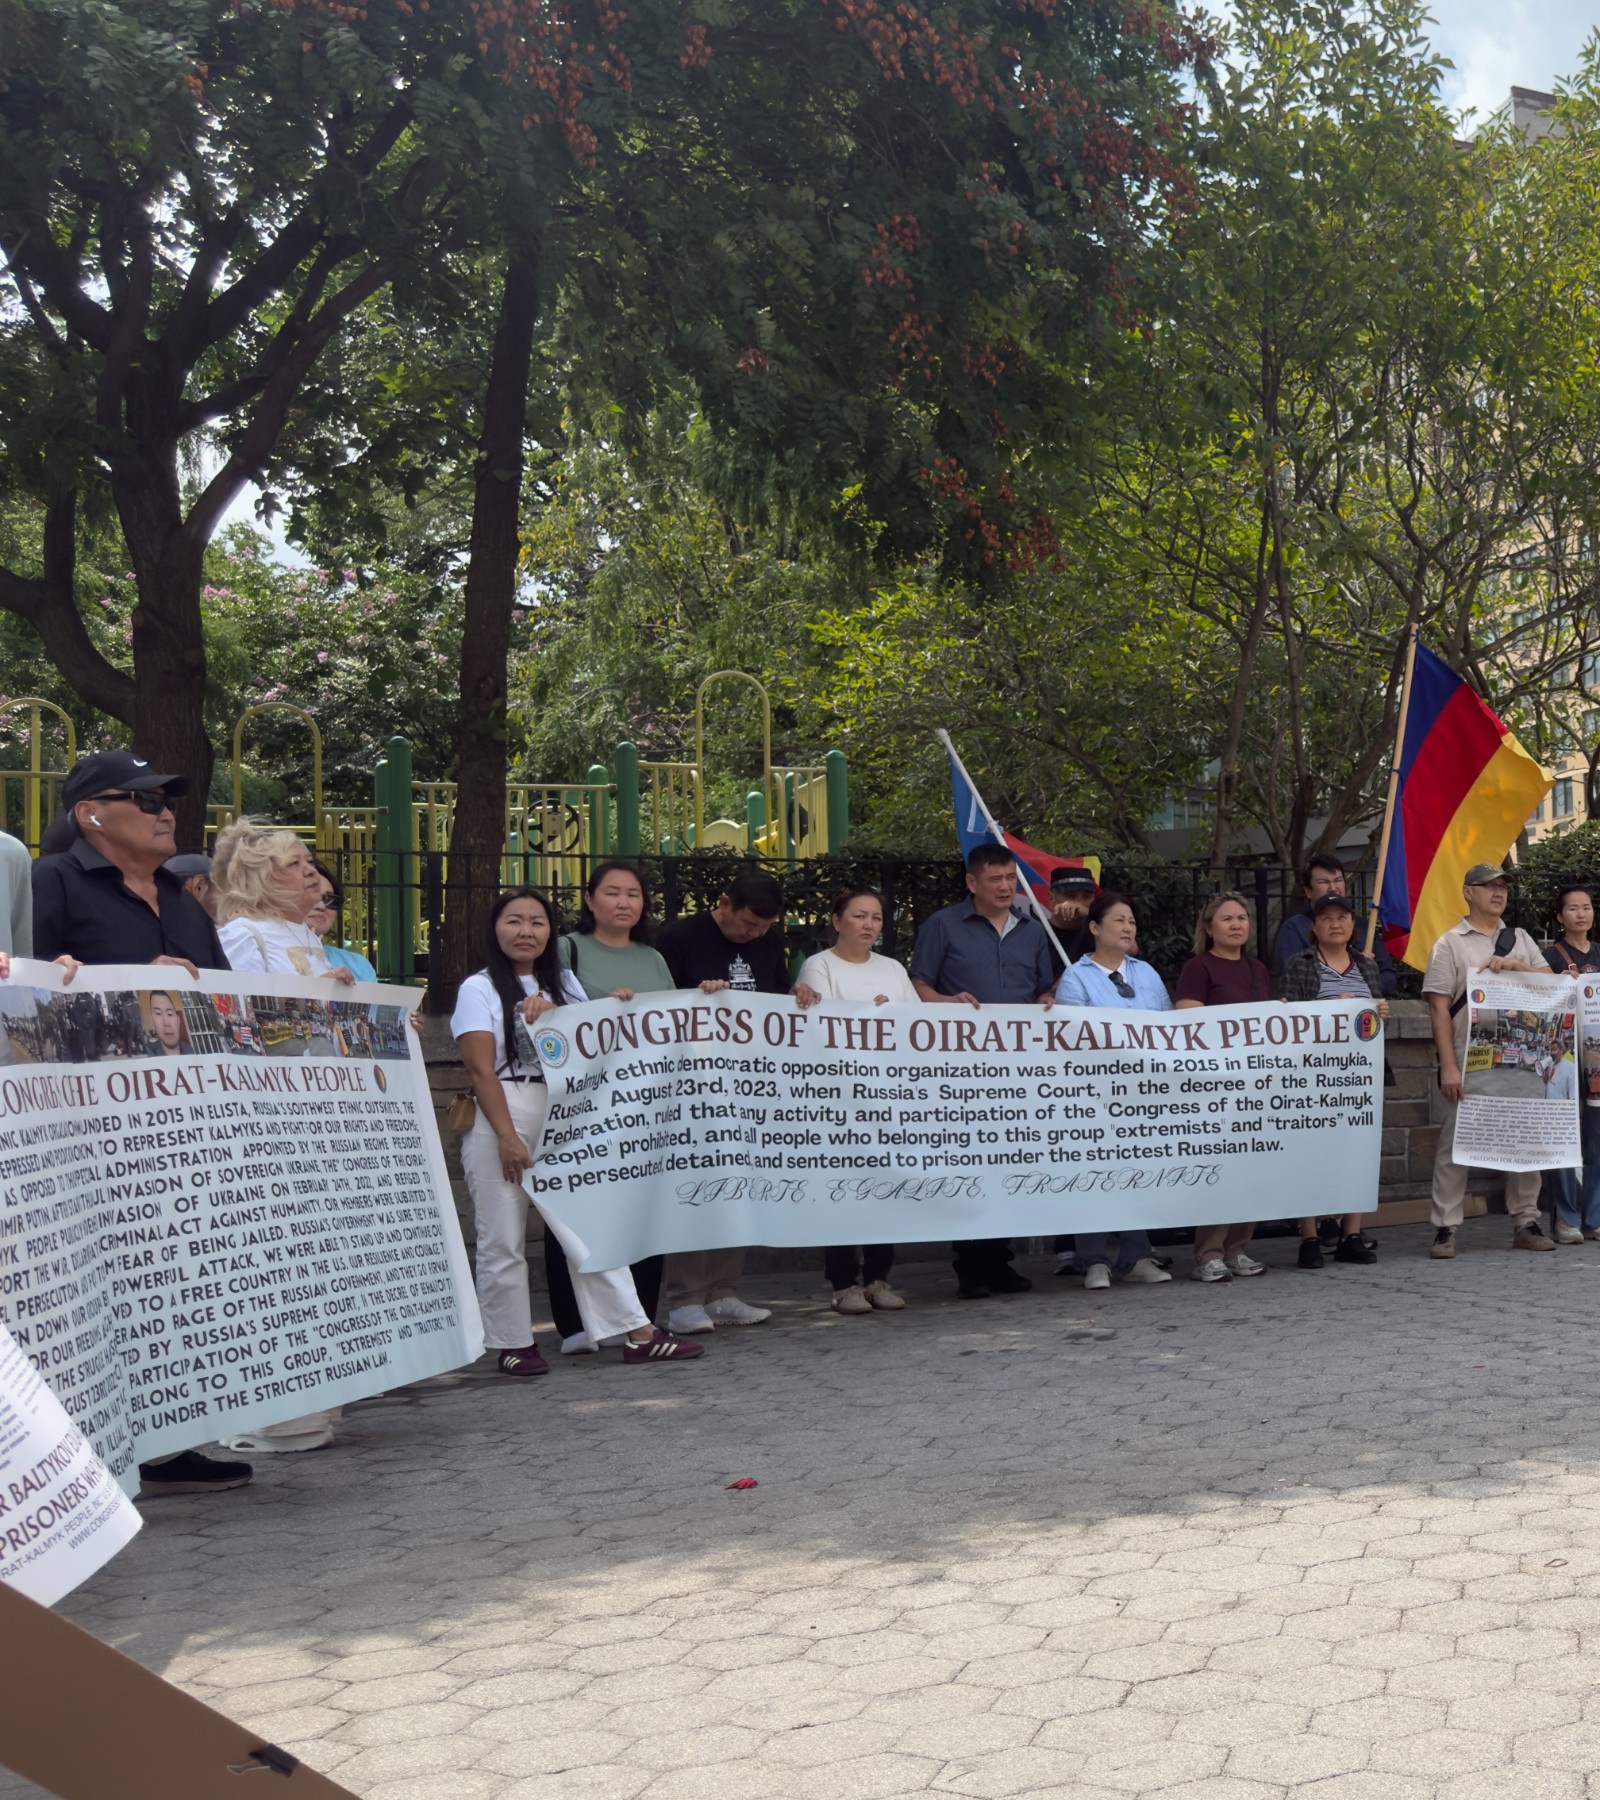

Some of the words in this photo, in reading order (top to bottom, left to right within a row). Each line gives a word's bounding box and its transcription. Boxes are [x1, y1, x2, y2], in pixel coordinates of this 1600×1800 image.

[575, 1007, 753, 1060] CONGRESS
[763, 1011, 807, 1047] OF
[819, 1015, 897, 1051] THE
[909, 1018, 1210, 1051] OIRAT-KALMYK
[1217, 1013, 1350, 1050] PEOPLE
[107, 1063, 300, 1104] OIRAT-KALMYK
[300, 1065, 367, 1093] PEOPLE
[565, 1067, 609, 1095] Kalmyk
[615, 1056, 675, 1081] ethnic
[677, 1055, 776, 1074] democratic
[781, 1060, 880, 1079] opposition
[886, 1061, 1010, 1081] organization
[1017, 1064, 1057, 1077] was
[1063, 1059, 1144, 1077] founded
[1151, 1057, 1167, 1073] in
[1173, 1058, 1219, 1073] 2015
[1225, 1056, 1241, 1071] in
[1247, 1054, 1298, 1071] Elista,
[1303, 1052, 1373, 1070] Kalmykia,
[548, 1097, 598, 1122] Russia.
[610, 1080, 673, 1107] August
[675, 1077, 728, 1097] 23rd,
[734, 1079, 781, 1101] 2023,
[790, 1082, 841, 1099] when
[853, 1083, 928, 1100] Russia's
[939, 1083, 1026, 1103] Supreme
[1037, 1082, 1101, 1100] Court,
[1111, 1080, 1127, 1096] in
[1137, 1080, 1170, 1095] the
[1180, 1077, 1245, 1093] decree
[1254, 1075, 1272, 1090] of
[1281, 1075, 1308, 1089] the
[1316, 1072, 1373, 1087] Russian
[146, 1107, 185, 1128] 2015
[208, 1101, 251, 1120] ELISTA,
[542, 1111, 650, 1147] Federation,
[655, 1107, 681, 1124] ruled
[689, 1102, 737, 1120] that
[740, 1106, 766, 1124] any
[774, 1105, 847, 1125] activity
[855, 1106, 892, 1122] and
[900, 1106, 1027, 1125] participation
[1035, 1105, 1056, 1120] of
[1064, 1104, 1096, 1119] the
[1103, 1101, 1200, 1119] "Congress
[1207, 1098, 1228, 1113] of
[1236, 1097, 1263, 1111] the
[1270, 1091, 1373, 1110] Oirat-Kalmyk
[123, 1127, 204, 1153] REPRESENT
[209, 1121, 264, 1142] KALMYKS
[619, 1128, 698, 1158] prohibited,
[705, 1126, 742, 1143] and
[744, 1127, 757, 1143] all
[761, 1130, 821, 1148] people
[828, 1130, 872, 1145] who
[878, 1129, 971, 1148] belonging
[977, 1129, 999, 1143] to
[1005, 1127, 1042, 1142] this
[1047, 1126, 1105, 1145] group
[1110, 1119, 1225, 1138] "extremists"
[1231, 1116, 1262, 1132] and
[1348, 1111, 1374, 1126] will
[106, 1146, 233, 1180] ADMINISTRATION
[218, 1162, 284, 1184] SOVEREIGN
[532, 1175, 562, 1193] be
[568, 1157, 664, 1192] persecuted,
[666, 1151, 753, 1171] detained,
[754, 1152, 782, 1168] and
[787, 1152, 891, 1169] sentenced
[896, 1153, 917, 1167] to
[922, 1153, 982, 1170] prison
[987, 1149, 1044, 1166] under
[1050, 1147, 1082, 1163] the
[1086, 1143, 1173, 1161] strictest
[1178, 1141, 1248, 1157] Russian
[1251, 1138, 1284, 1152] law.
[209, 1185, 266, 1207] UKRAINE
[242, 1226, 287, 1247] JAILED.
[112, 1266, 190, 1298] POWERFUL
[198, 1253, 260, 1279] ATTACK,
[228, 1271, 293, 1294] COUNTRY
[262, 1306, 319, 1332] SUPREME
[254, 1370, 322, 1403] STRICTEST
